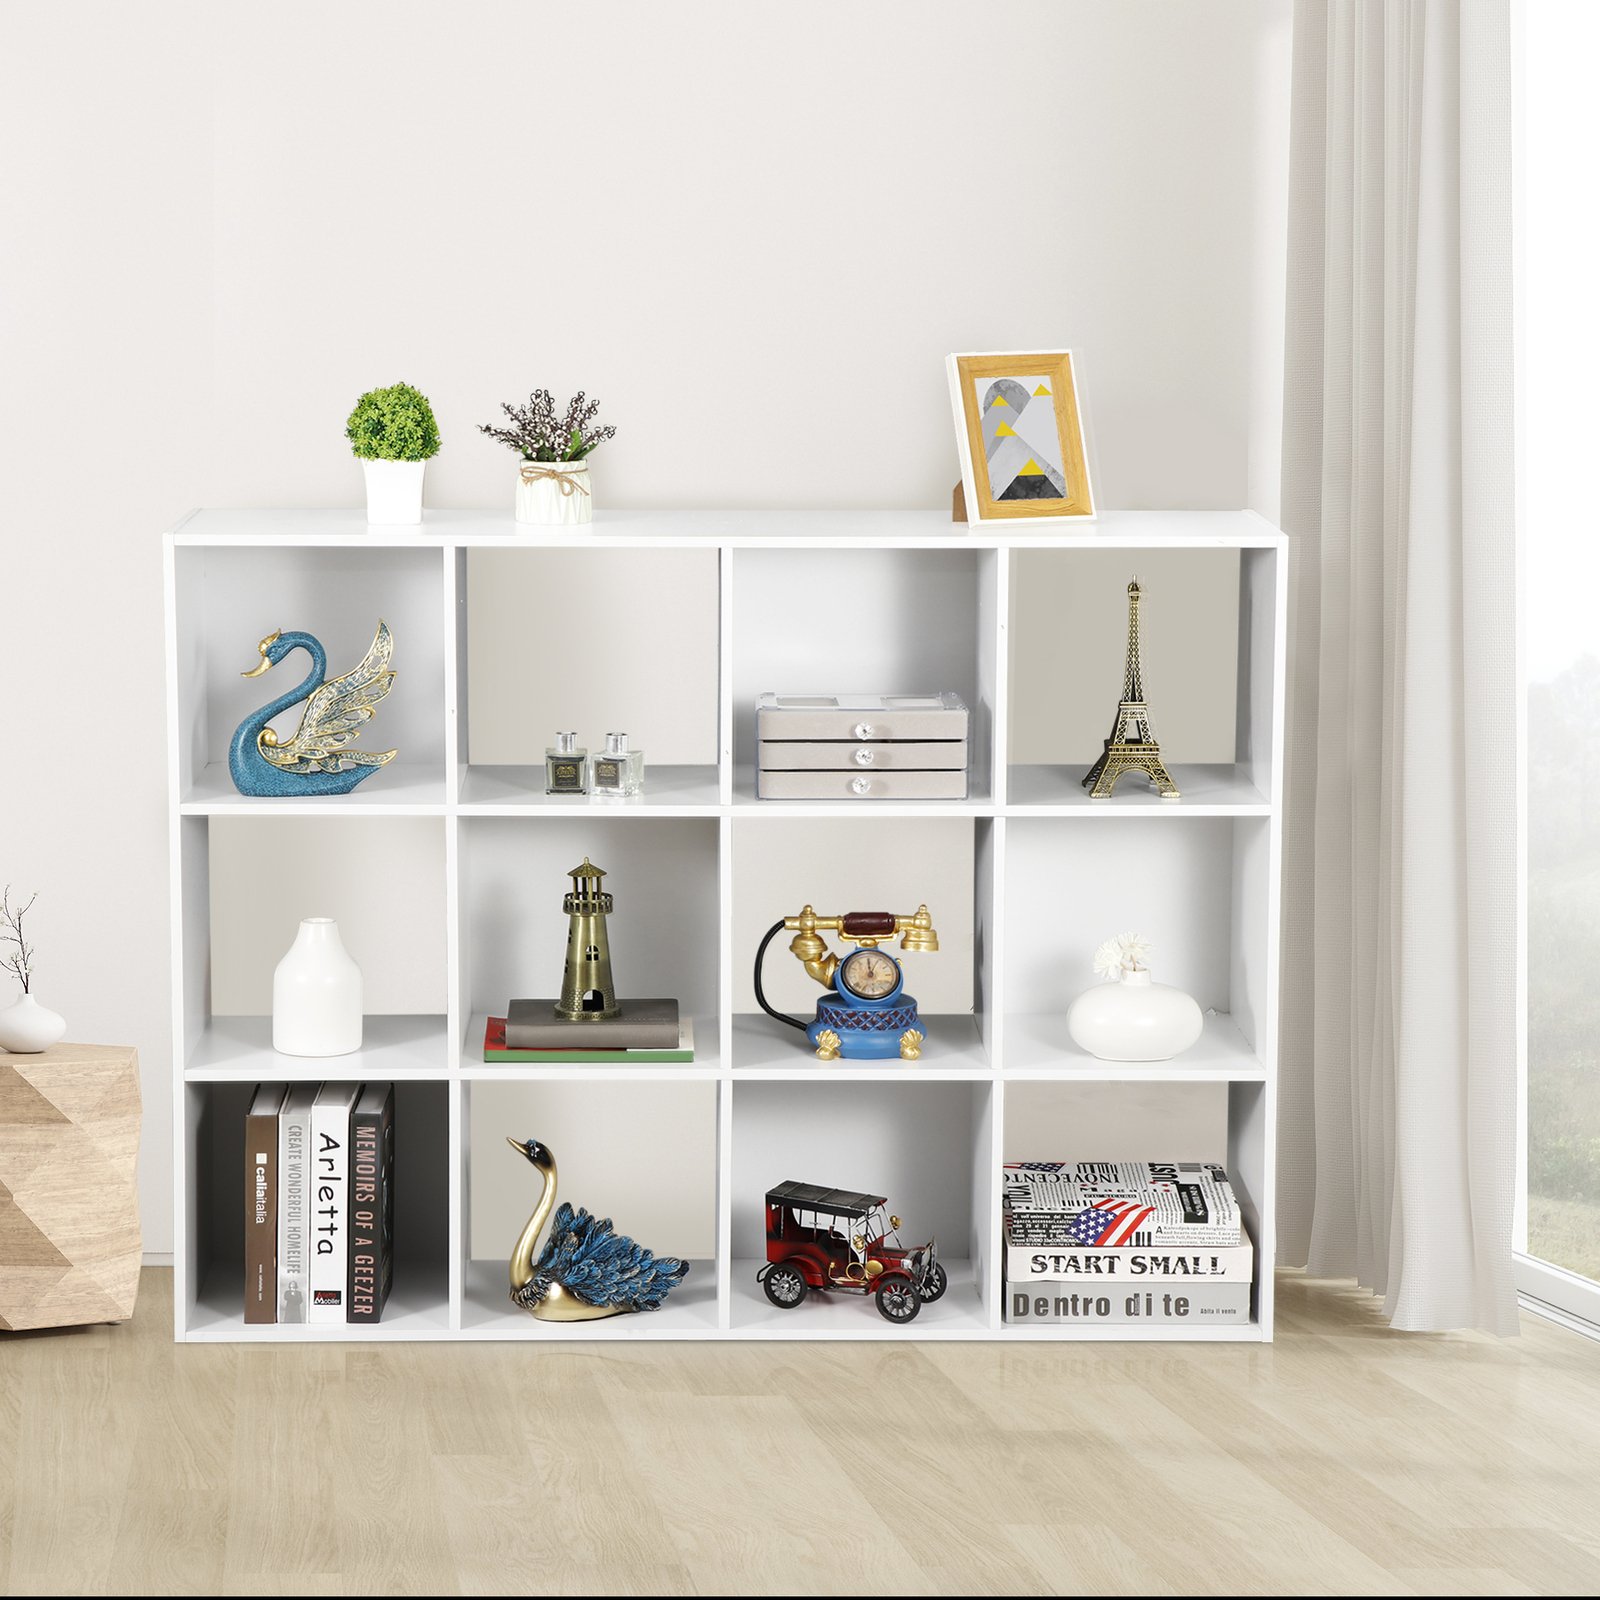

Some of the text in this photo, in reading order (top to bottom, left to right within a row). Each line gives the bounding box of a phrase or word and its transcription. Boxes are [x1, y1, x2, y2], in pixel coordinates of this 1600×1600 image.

[255, 1166, 268, 1224] caliaitalia
[286, 1125, 302, 1274] CREATE WONDERFUL HOMELIFE
[317, 1132, 342, 1255] Arletta
[353, 1126, 376, 1315] MEMOIRS OF A GEEZER
[1012, 1293, 1190, 1318] Dentro di te
[1030, 1254, 1227, 1276] START SMALL
